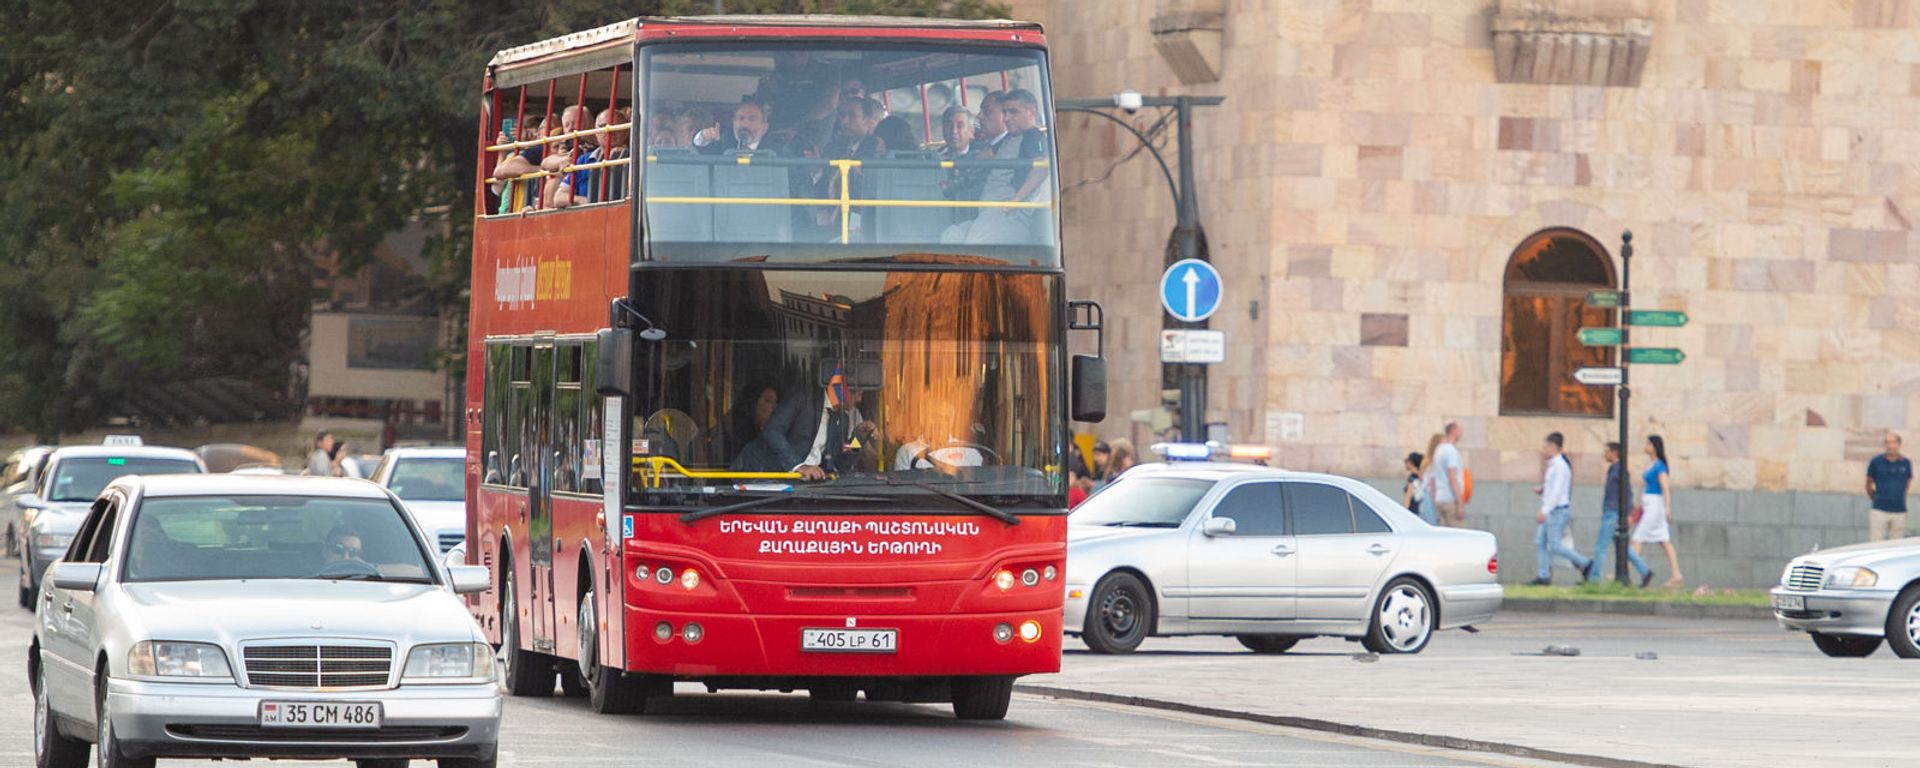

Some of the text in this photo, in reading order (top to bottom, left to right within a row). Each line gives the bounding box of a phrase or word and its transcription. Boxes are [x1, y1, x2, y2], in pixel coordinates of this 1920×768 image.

[719, 520, 980, 536] ԵՐԵՎԱՆ ՔԱՂԱՔԻ ՊԱՇՏՈՆԱԿԱՆ
[758, 540, 942, 555] ՔԱՂԱՔԱՅԻՆ ԵՐԹՈՒՂԻ
[817, 632, 890, 648] 405 LP 61
[286, 704, 375, 724] 35 CM 486
